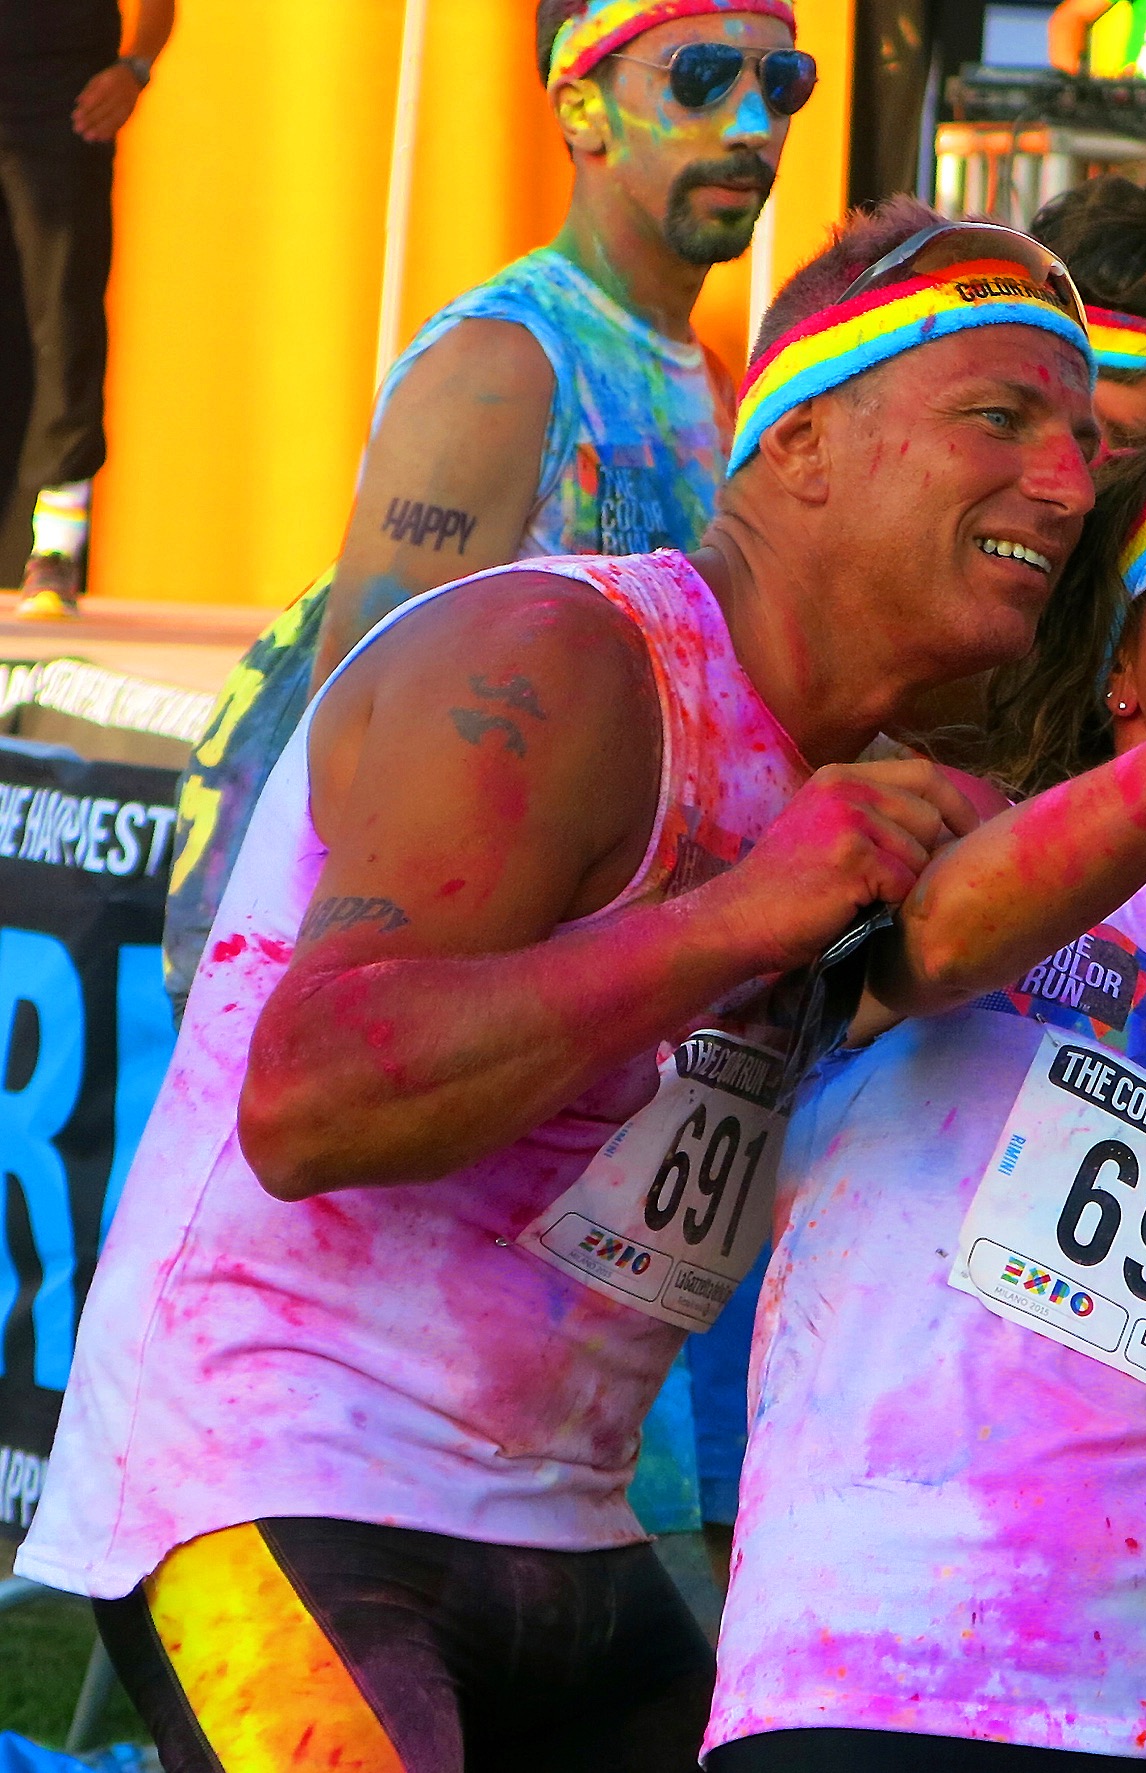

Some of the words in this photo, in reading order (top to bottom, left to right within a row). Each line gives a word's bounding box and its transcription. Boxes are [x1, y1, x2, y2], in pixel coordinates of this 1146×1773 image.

[381, 497, 477, 555] HAPPY
[1020, 966, 1085, 1008] RUN
[1038, 945, 1123, 999] OLOR
[680, 1040, 721, 1076] THE
[1061, 1051, 1116, 1101] THE
[997, 1134, 1026, 1176] RIMINI
[644, 1103, 768, 1257] 691
[579, 1228, 651, 1275] EXPO
[993, 1286, 1029, 1308] MILANO
[1029, 1301, 1050, 1318] 2015
[1001, 1256, 1094, 1317] EXPO
